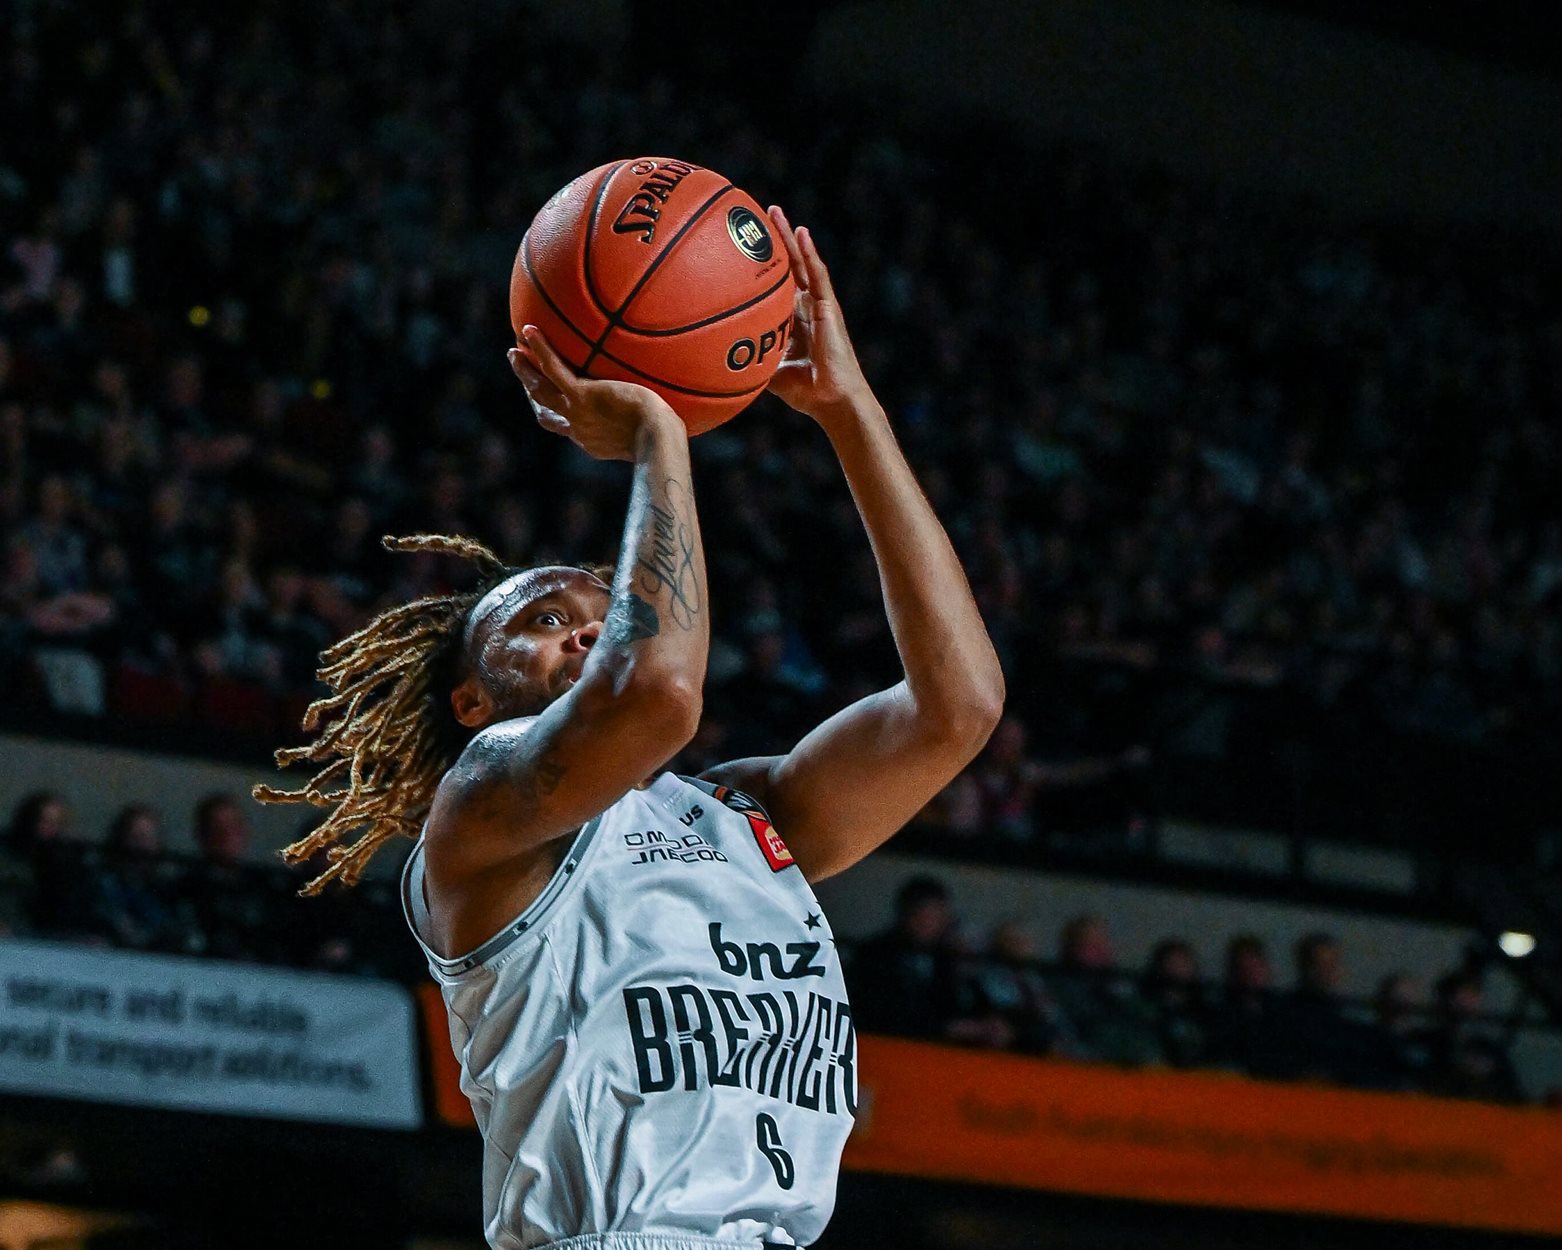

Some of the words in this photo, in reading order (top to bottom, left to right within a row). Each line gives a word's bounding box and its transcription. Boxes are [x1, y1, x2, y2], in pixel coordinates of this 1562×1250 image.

[708, 922, 826, 981] bnz
[623, 984, 857, 1117] BREAKER
[756, 1112, 795, 1191] 6
